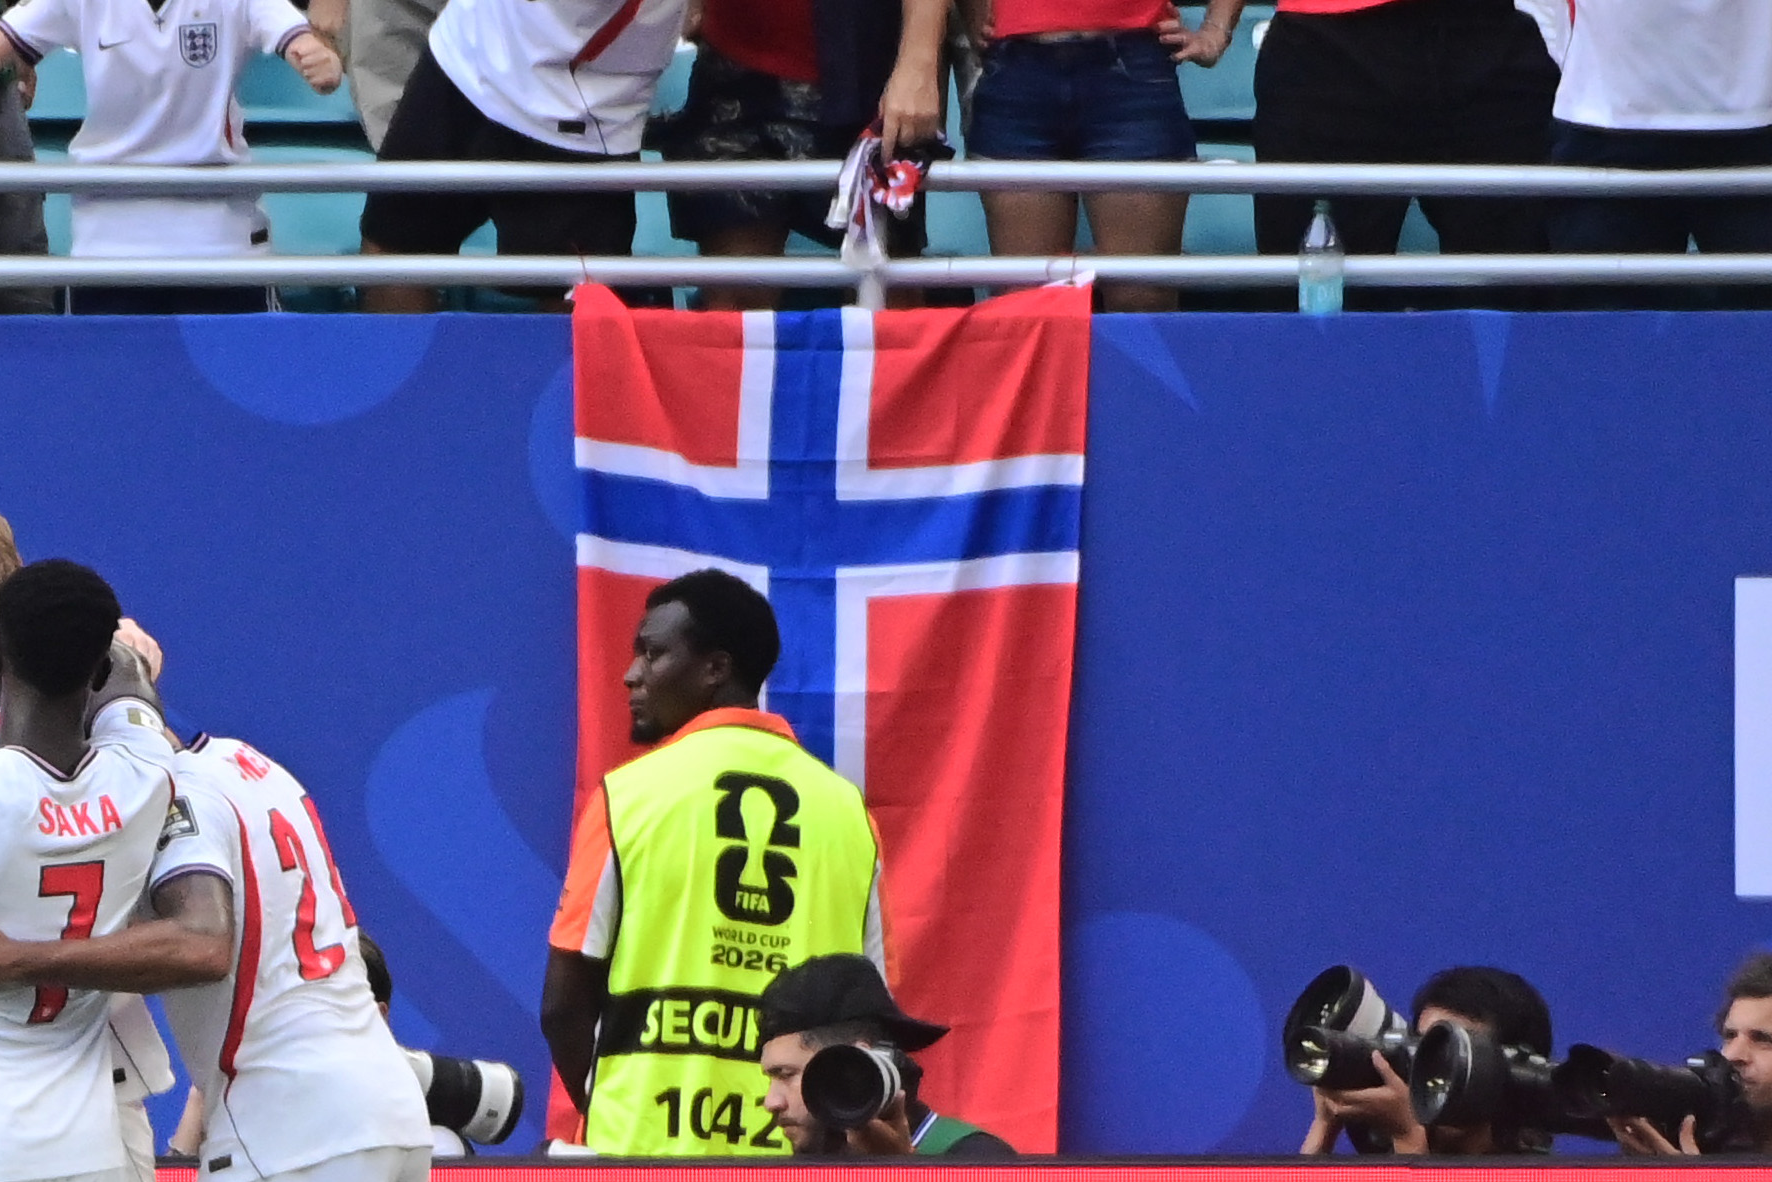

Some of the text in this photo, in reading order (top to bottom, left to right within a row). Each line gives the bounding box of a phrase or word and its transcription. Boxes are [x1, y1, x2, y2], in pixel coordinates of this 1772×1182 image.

[38, 794, 123, 837] SAKA
[734, 890, 771, 914] FIFA
[27, 860, 105, 1024] 7
[712, 926, 792, 951] WORLD CUP
[710, 944, 789, 975] 2026
